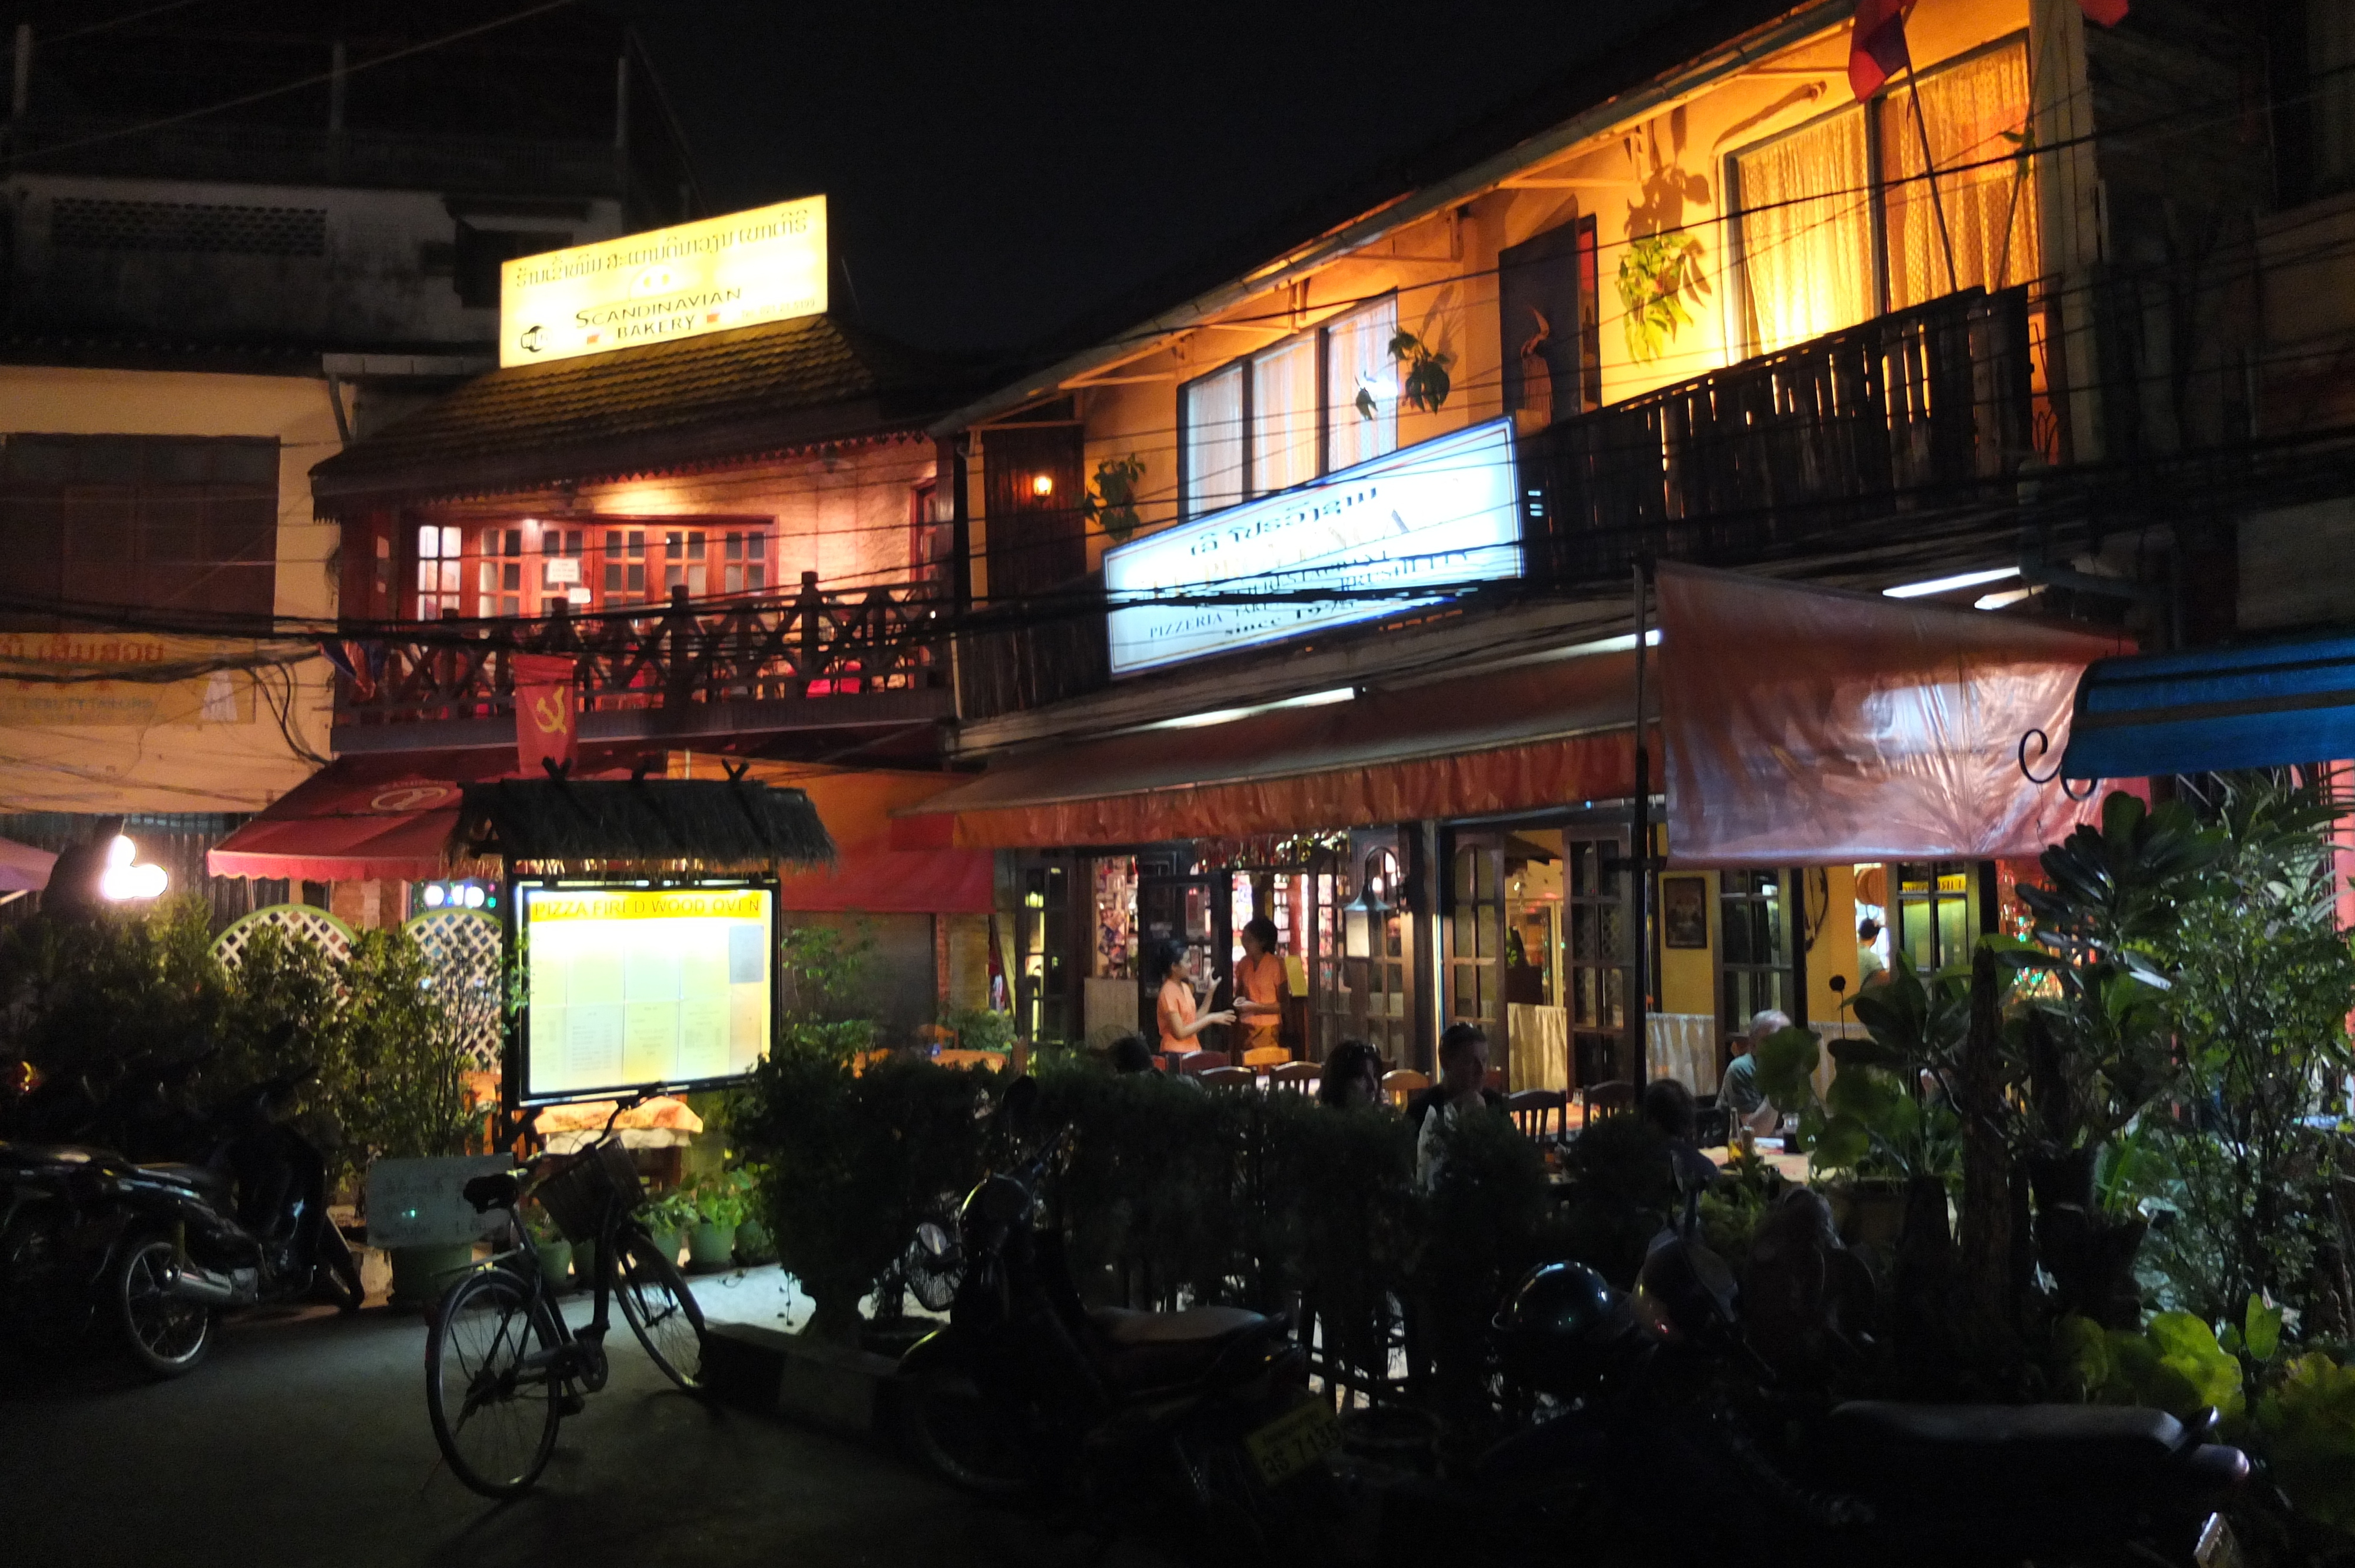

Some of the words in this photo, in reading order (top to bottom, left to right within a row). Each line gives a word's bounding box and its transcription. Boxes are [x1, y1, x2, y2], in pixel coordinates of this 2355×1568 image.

[575, 288, 741, 328] SCANDINAVIAN
[617, 314, 696, 340] BAKERY
[1150, 613, 1223, 639] PIZZERIA
[534, 900, 588, 916] PIZZA
[651, 898, 705, 913] WOOD
[712, 898, 759, 913] OVEN
